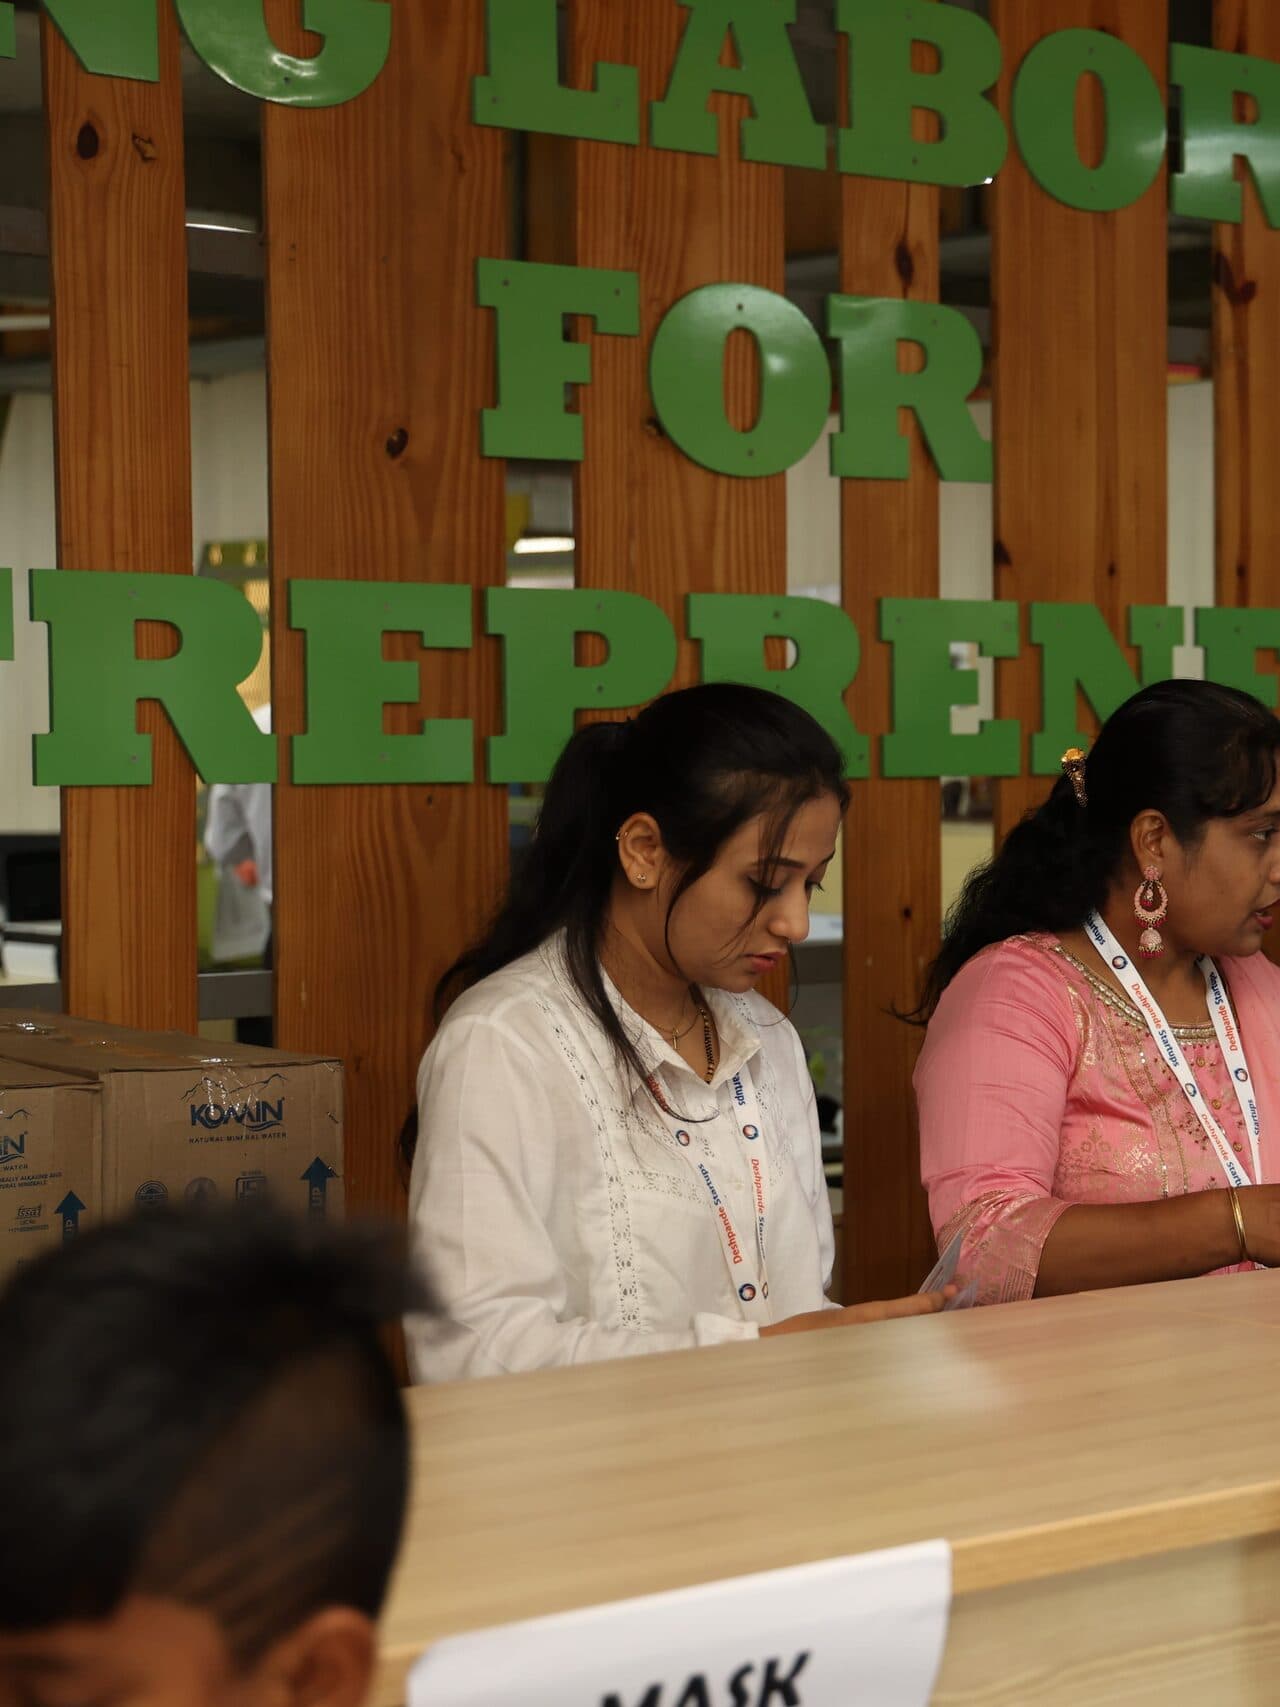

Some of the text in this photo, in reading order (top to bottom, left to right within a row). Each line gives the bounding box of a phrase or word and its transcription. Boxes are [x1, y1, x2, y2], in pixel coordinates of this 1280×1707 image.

[478, 257, 992, 483] FOR
[1131, 983, 1181, 1068] Deshpande Startups
[1209, 972, 1238, 1051] Deshpande Startups
[731, 1072, 746, 1106] artups
[189, 1136, 225, 1144] NATURAL
[698, 1163, 743, 1264] Deshpande Startups
[751, 1159, 765, 1214] Deshpande
